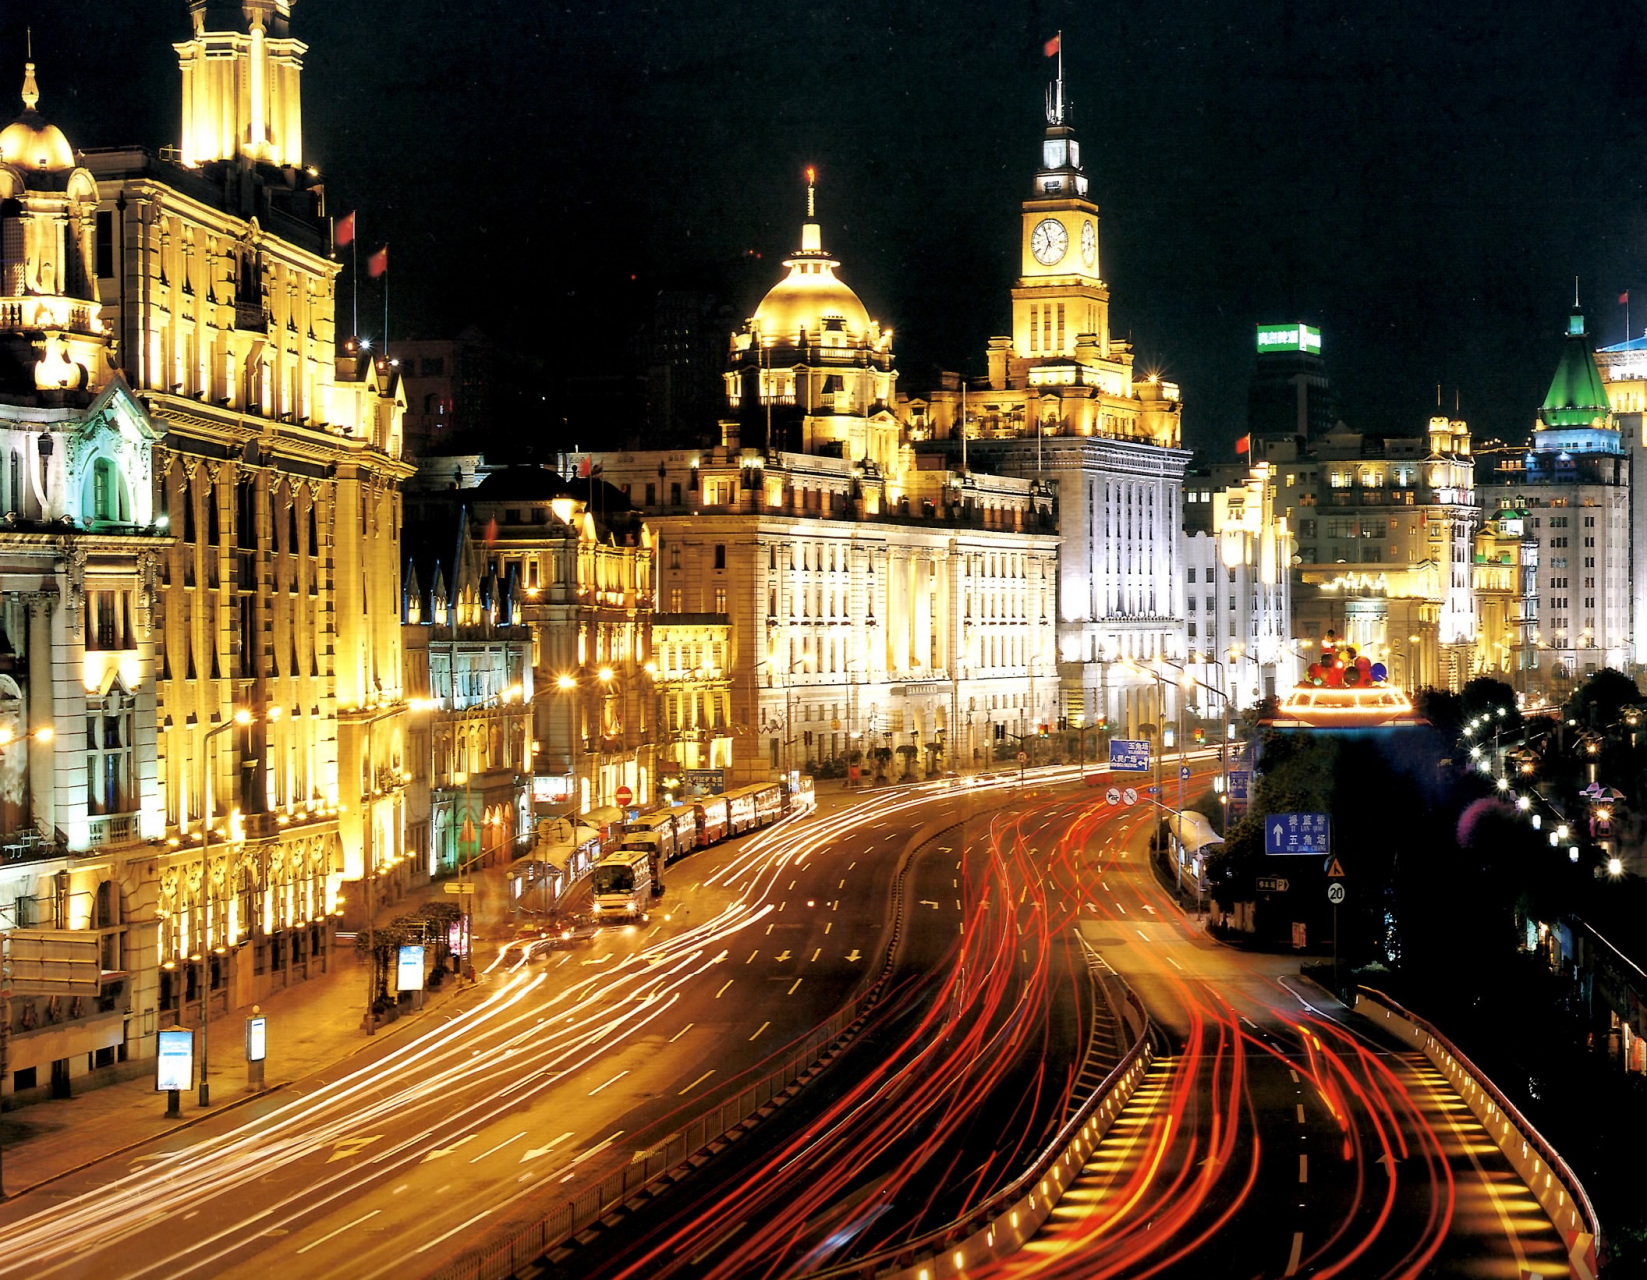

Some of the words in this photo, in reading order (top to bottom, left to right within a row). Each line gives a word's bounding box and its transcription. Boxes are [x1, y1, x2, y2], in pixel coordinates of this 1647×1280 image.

[1111, 755, 1137, 763] 人民广场
[1289, 815, 1325, 825] 提篮桥
[1289, 835, 1326, 845] 五角场
[1330, 888, 1343, 900] 20
